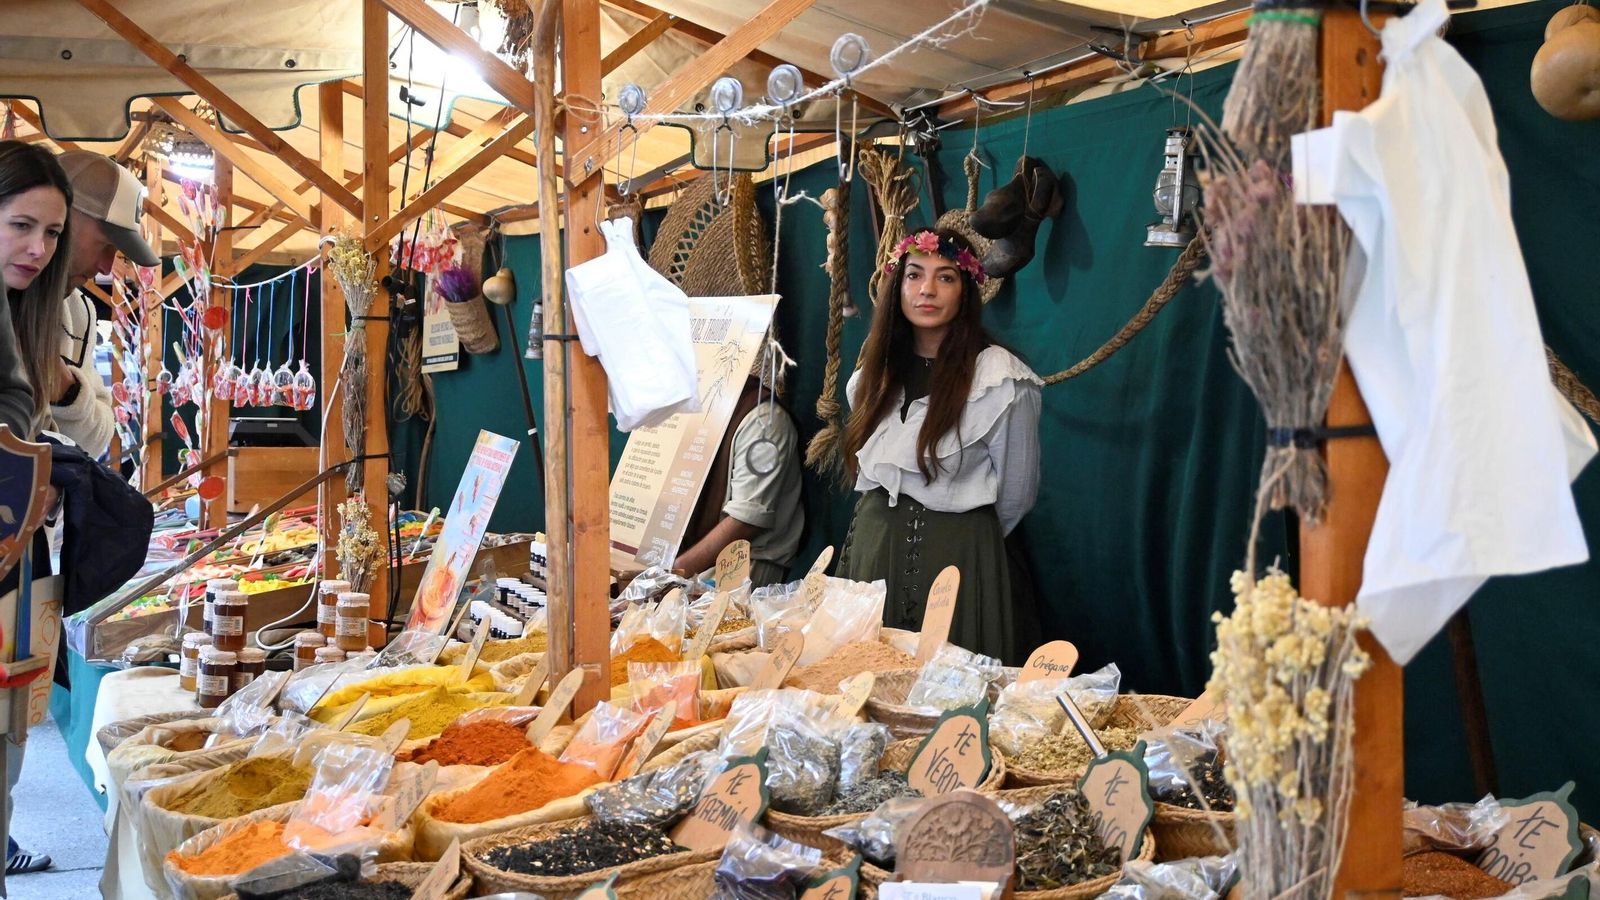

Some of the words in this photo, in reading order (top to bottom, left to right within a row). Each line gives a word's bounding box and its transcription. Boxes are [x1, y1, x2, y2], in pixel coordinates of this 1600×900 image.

[31, 599, 60, 724] RORIGO
[1032, 655, 1070, 677] Orégano
[924, 746, 967, 794] VERD
